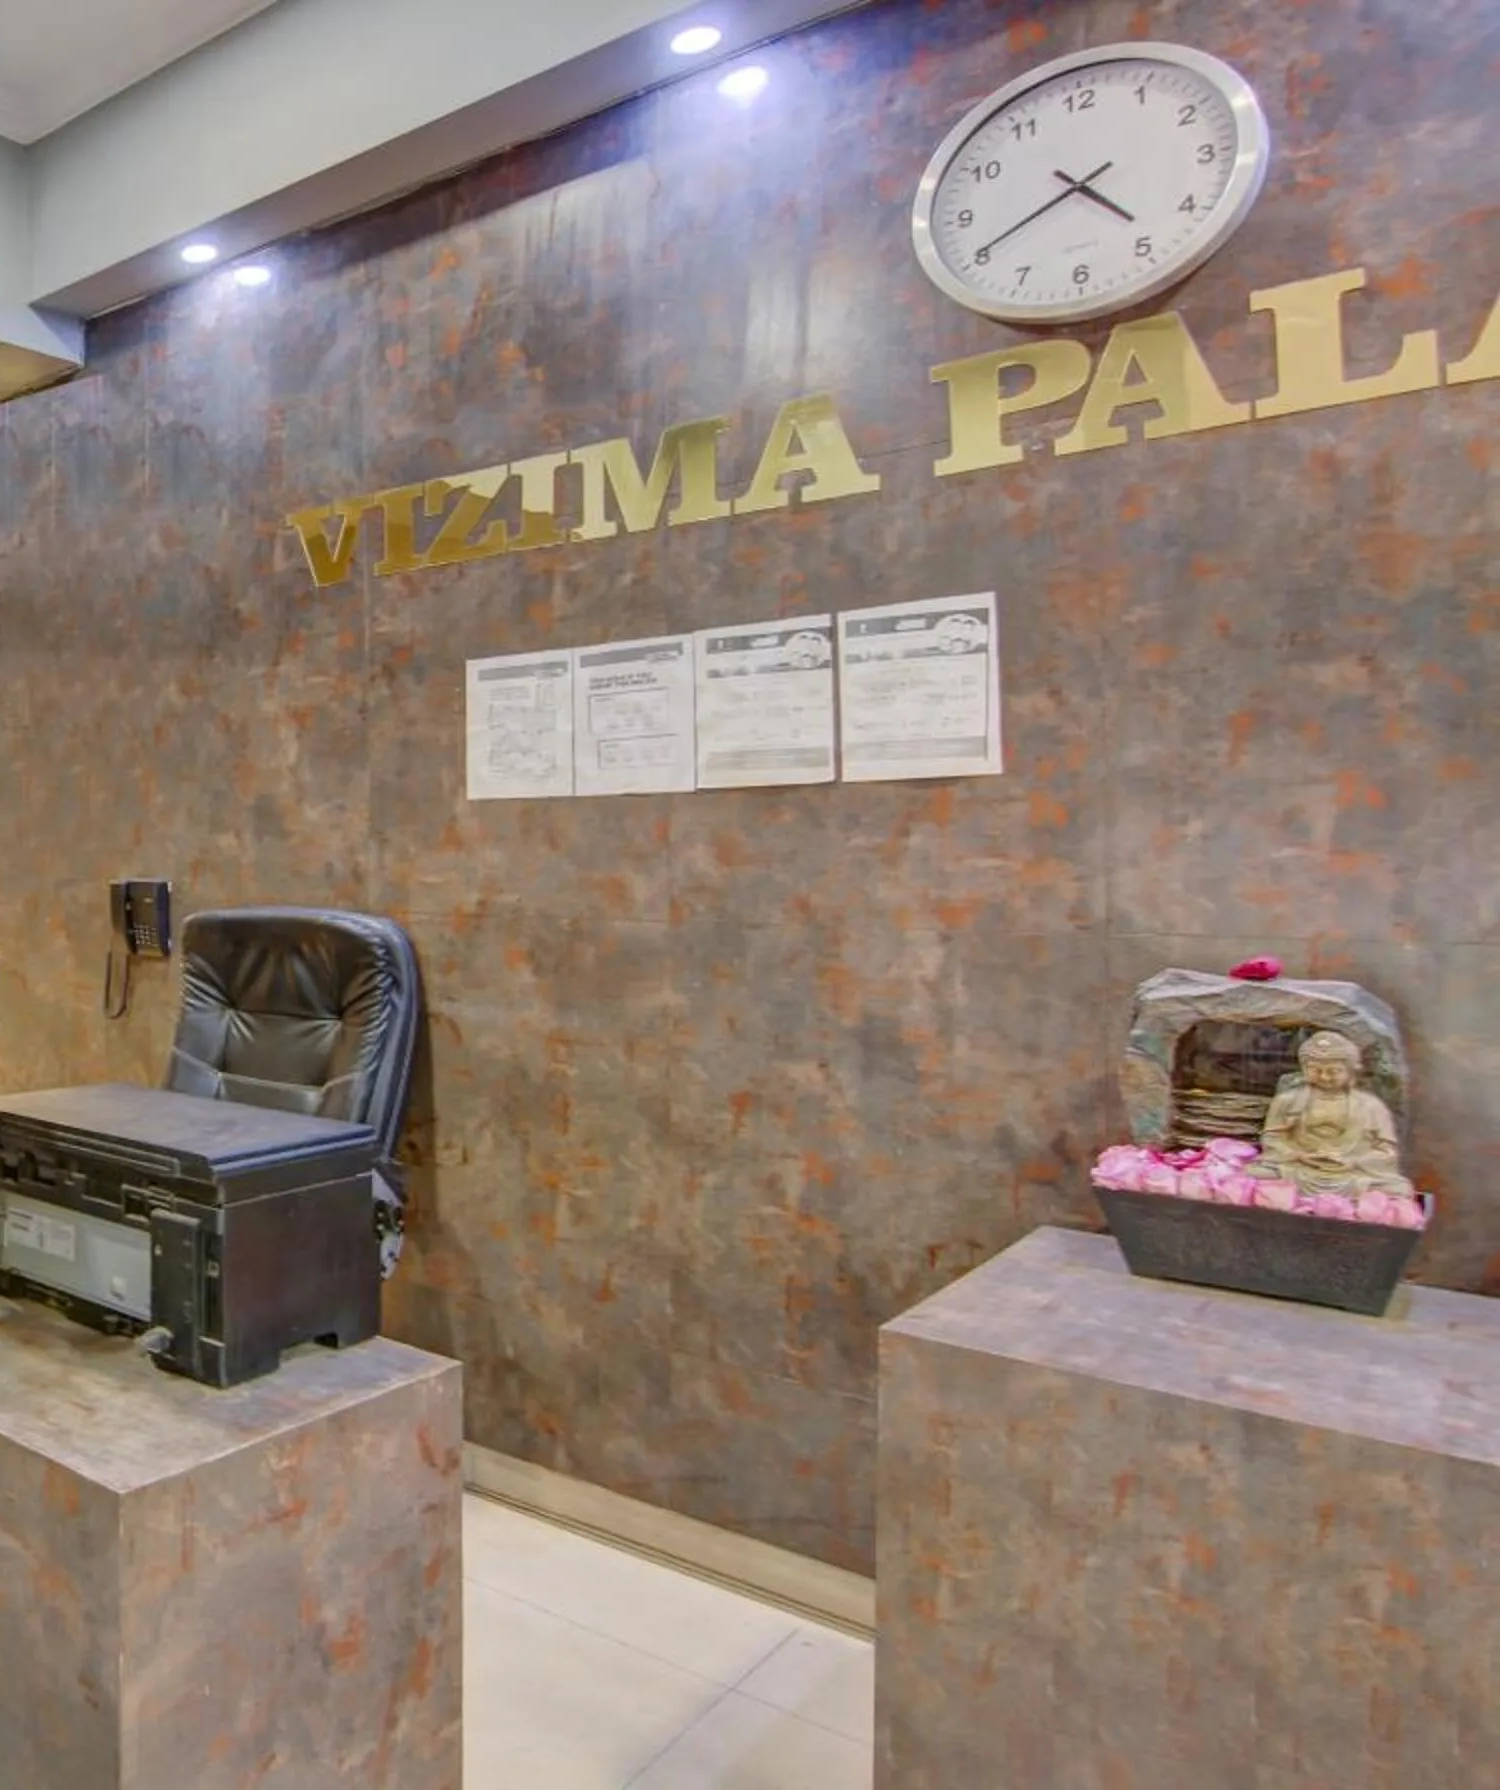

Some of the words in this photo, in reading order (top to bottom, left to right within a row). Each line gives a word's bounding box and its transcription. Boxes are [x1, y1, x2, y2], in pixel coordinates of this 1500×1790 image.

[1061, 88, 1096, 115] 12
[1133, 85, 1146, 105] 1
[1176, 104, 1197, 127] 2
[1010, 118, 1037, 141] 11
[1196, 143, 1215, 164] 3
[969, 160, 1001, 184] 10
[1177, 194, 1196, 214] 4
[957, 209, 974, 229] 9
[973, 247, 992, 266] 8
[1133, 237, 1152, 258] 5
[1014, 265, 1032, 287] 7
[1071, 264, 1090, 285] 6
[286, 392, 881, 588] VIZIMA
[930, 267, 1500, 477] PAL
